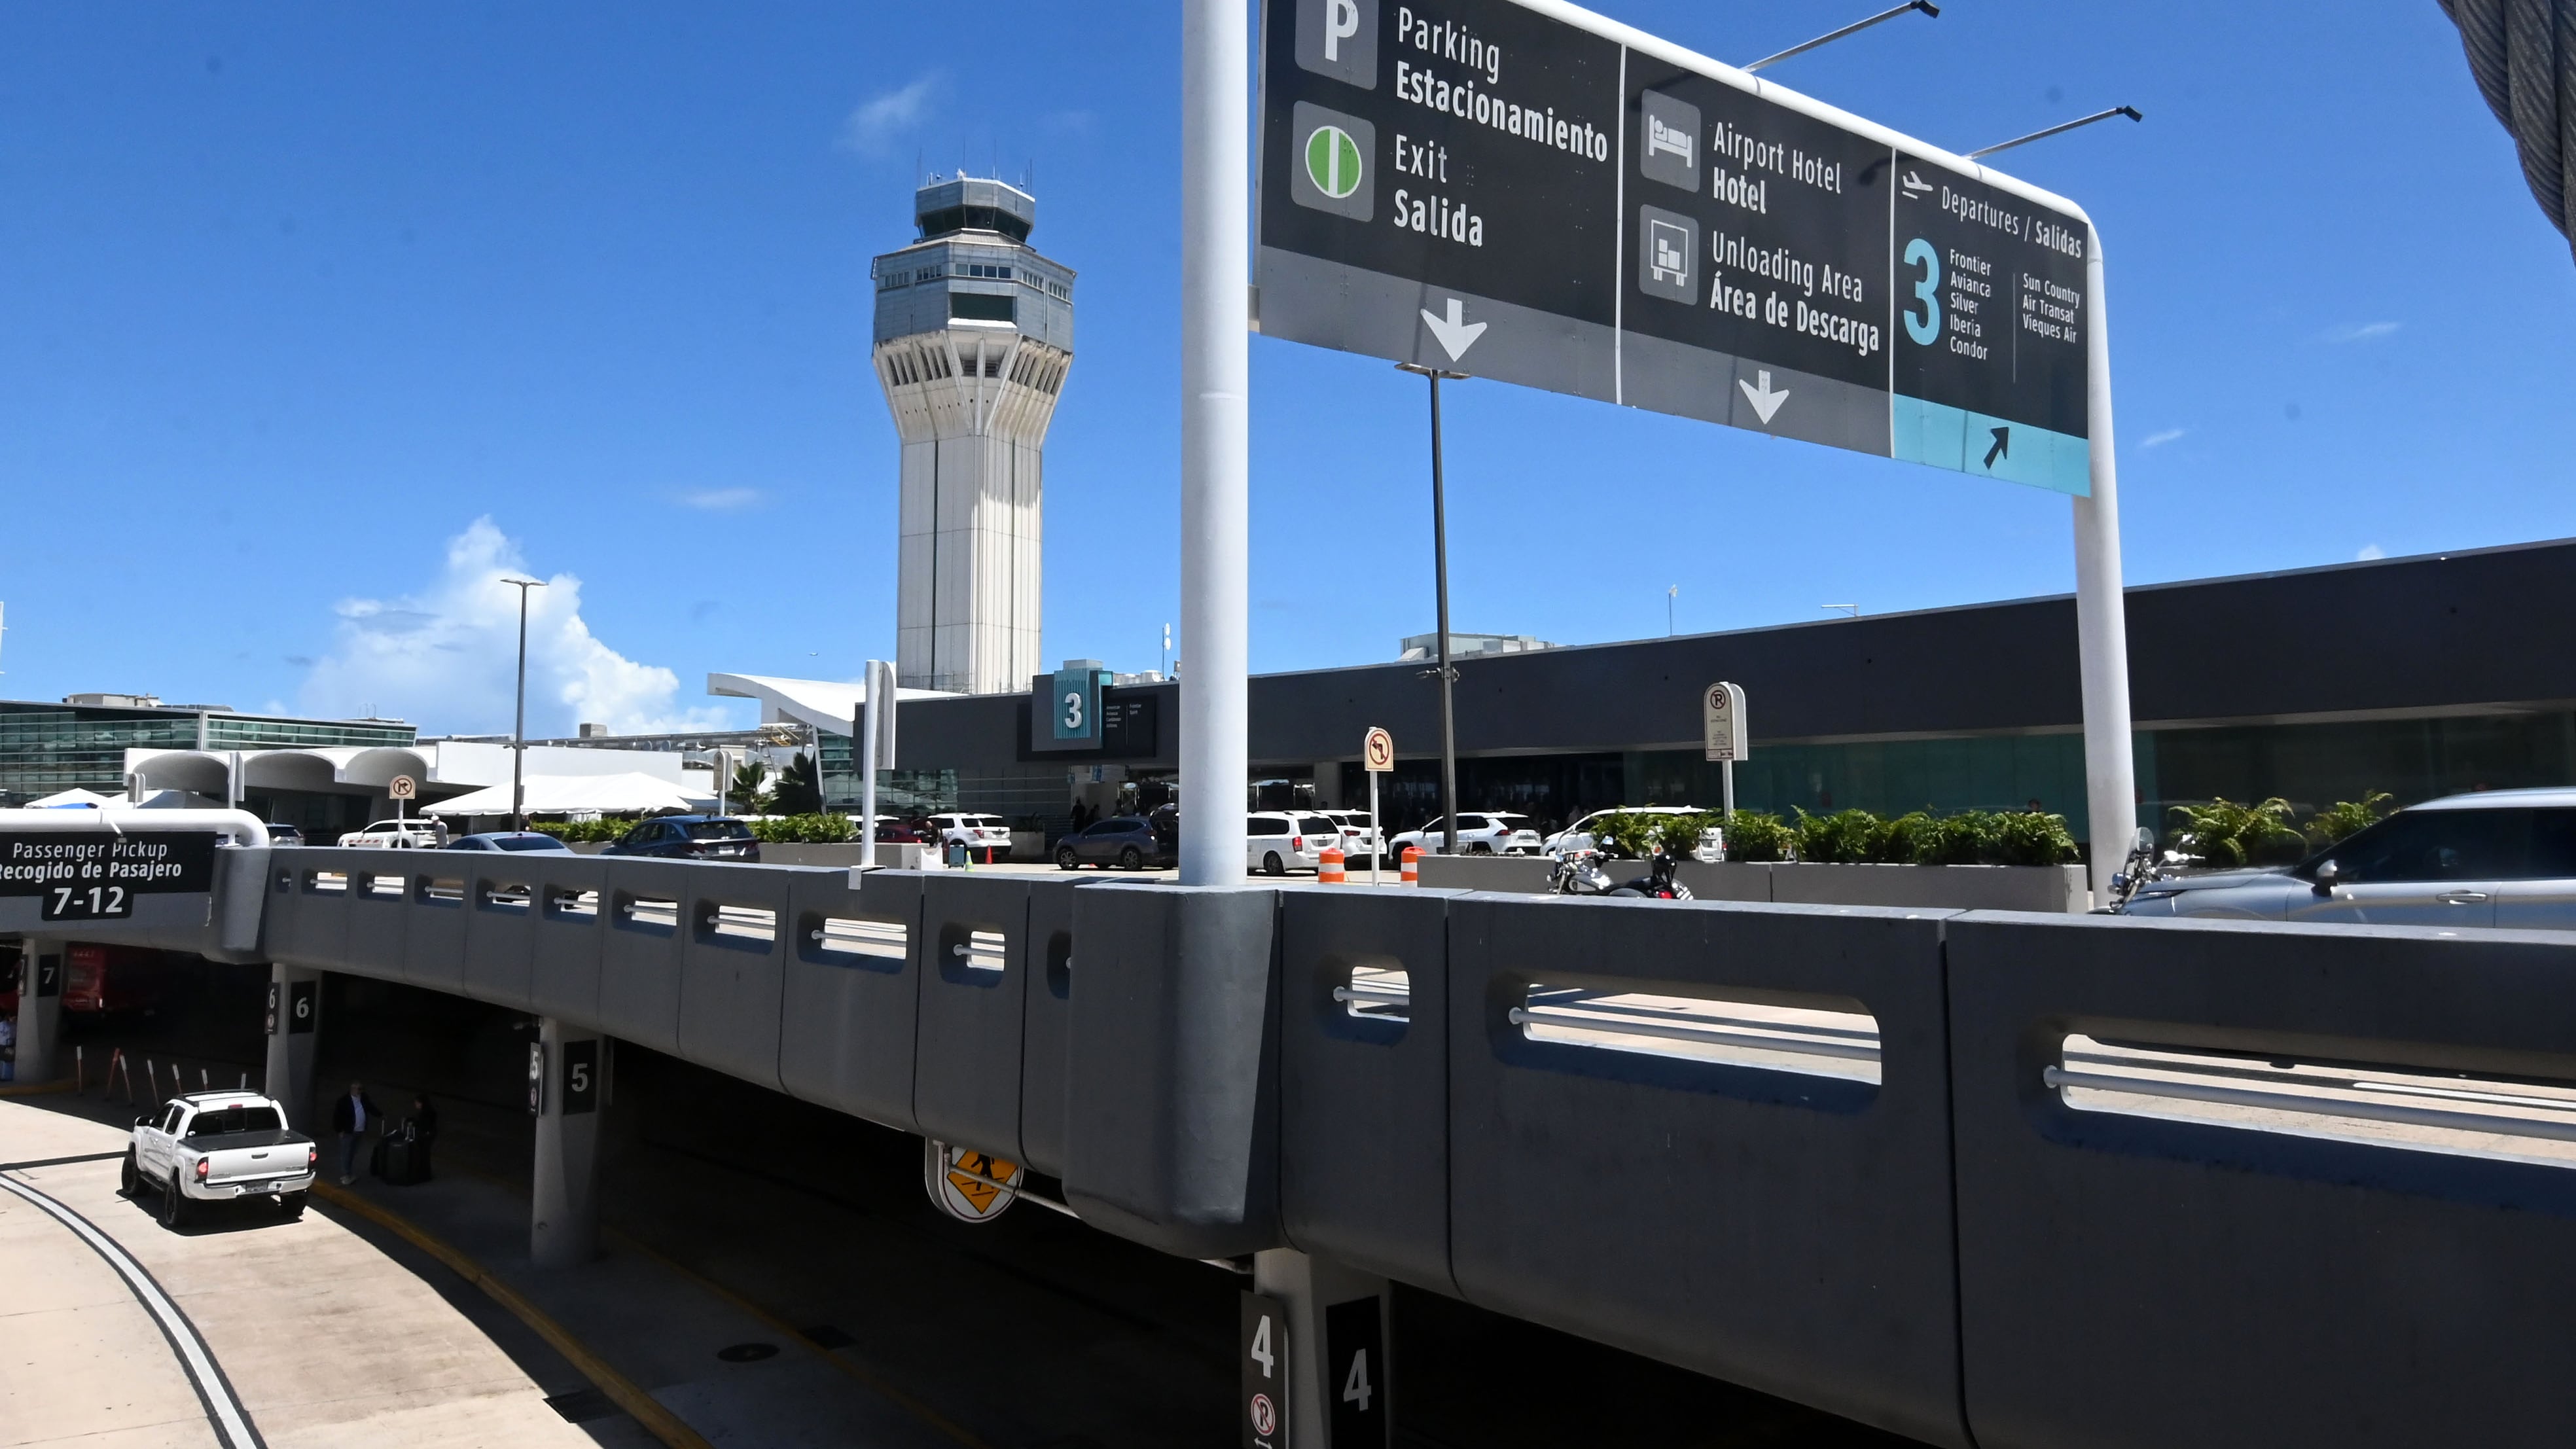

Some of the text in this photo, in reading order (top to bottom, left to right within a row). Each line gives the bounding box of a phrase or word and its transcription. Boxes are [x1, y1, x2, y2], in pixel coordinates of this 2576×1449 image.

[1325, 0, 1359, 62] P
[1398, 6, 1500, 84] Parking
[1395, 60, 1608, 162] Estacionamiento
[1395, 134, 1448, 184] Exit
[1713, 121, 1841, 194] Airport Hotel
[1713, 166, 1766, 215] Hotel
[1393, 188, 1483, 247] Salida
[1942, 185, 2081, 259] Departures / Salidas
[1713, 230, 1863, 303] Unloading Area
[1950, 248, 1992, 276] Frontier
[1903, 238, 1941, 346] 3
[1950, 270, 1991, 298] Avianca
[2023, 272, 2080, 310] Sun Country
[1709, 270, 1879, 357] Área de Descarga
[1950, 292, 1979, 315] Silver
[2022, 294, 2074, 325] Air Transat
[1950, 313, 1981, 338] Iberia
[2022, 313, 2077, 344] Vieques Air
[1950, 336, 1988, 361] Condor
[1065, 692, 1082, 728] 3
[13, 840, 168, 862] Passenger Pickup
[81, 861, 103, 878] de
[109, 860, 182, 881] Pasajero
[53, 886, 124, 915] 7-12
[43, 966, 55, 984] 7
[269, 988, 276, 1009] 6
[296, 996, 310, 1018] 6
[531, 1050, 539, 1080] 5
[571, 1062, 588, 1092] 5
[1251, 1314, 1274, 1378] 4
[1343, 1348, 1372, 1412] 4
